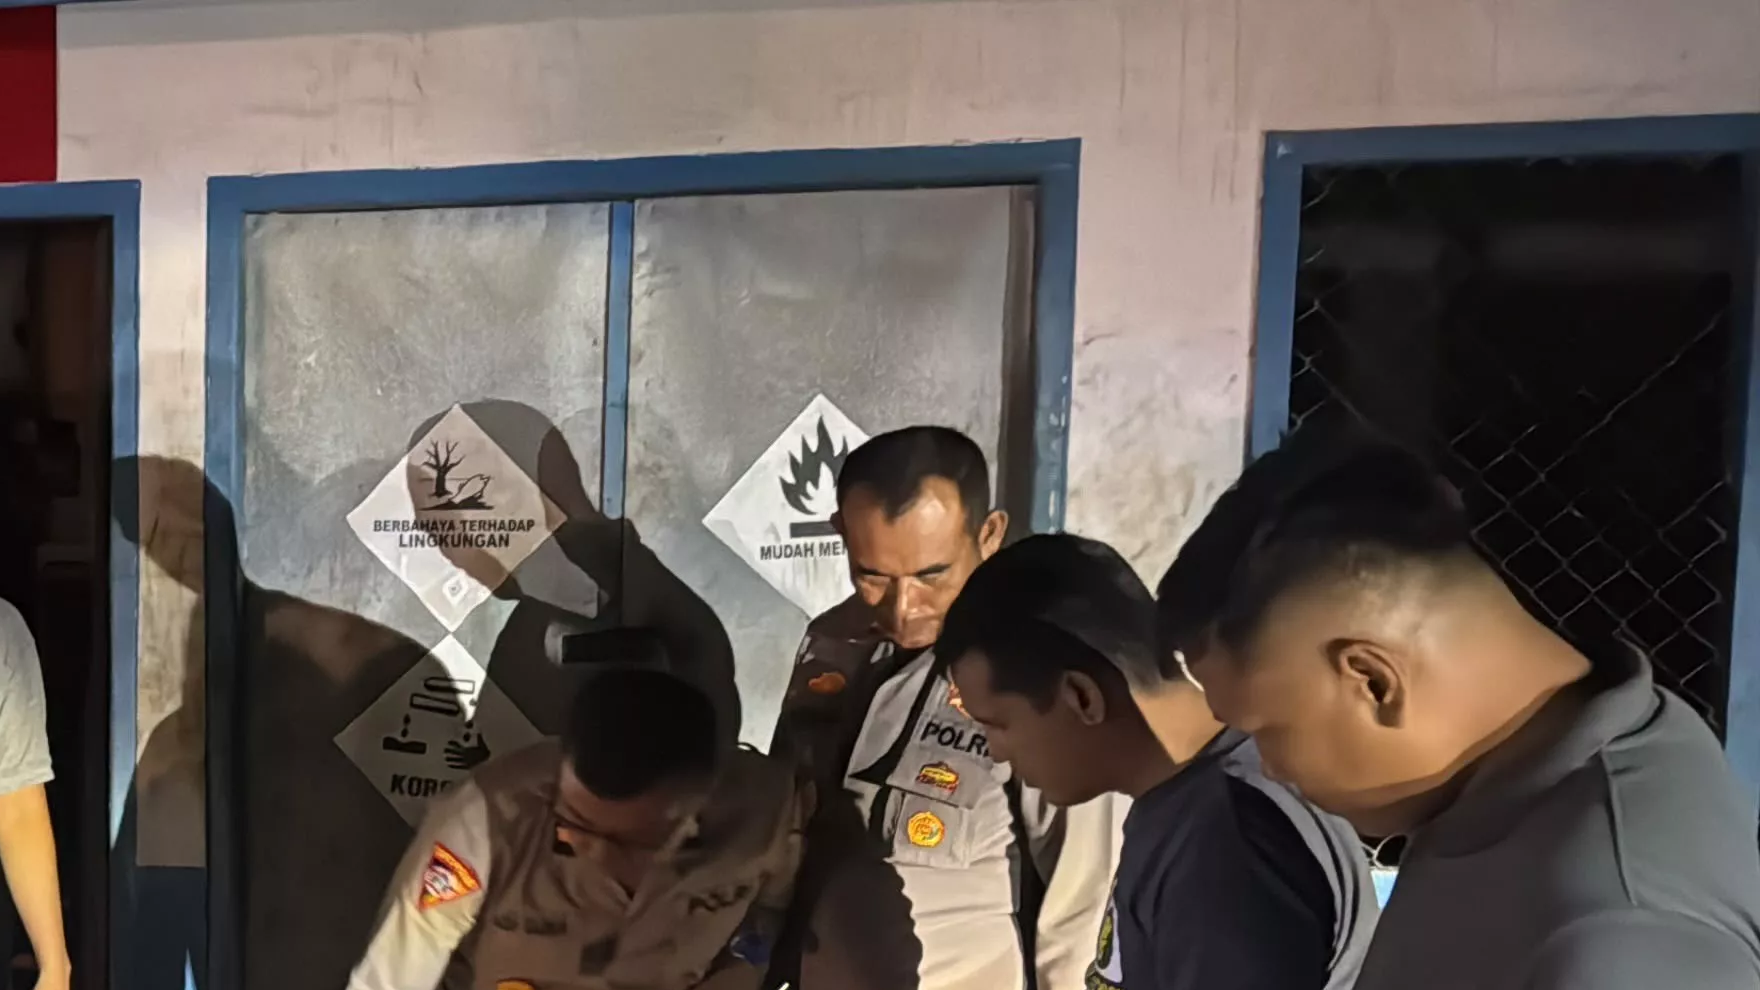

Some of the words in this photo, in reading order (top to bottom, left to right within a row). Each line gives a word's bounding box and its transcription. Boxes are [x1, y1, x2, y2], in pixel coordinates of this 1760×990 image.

[373, 519, 456, 533] BERBAHAYA
[460, 519, 535, 533] TERHADAP
[398, 533, 510, 549] LINGKUNGAN
[760, 542, 814, 560] MUDAH
